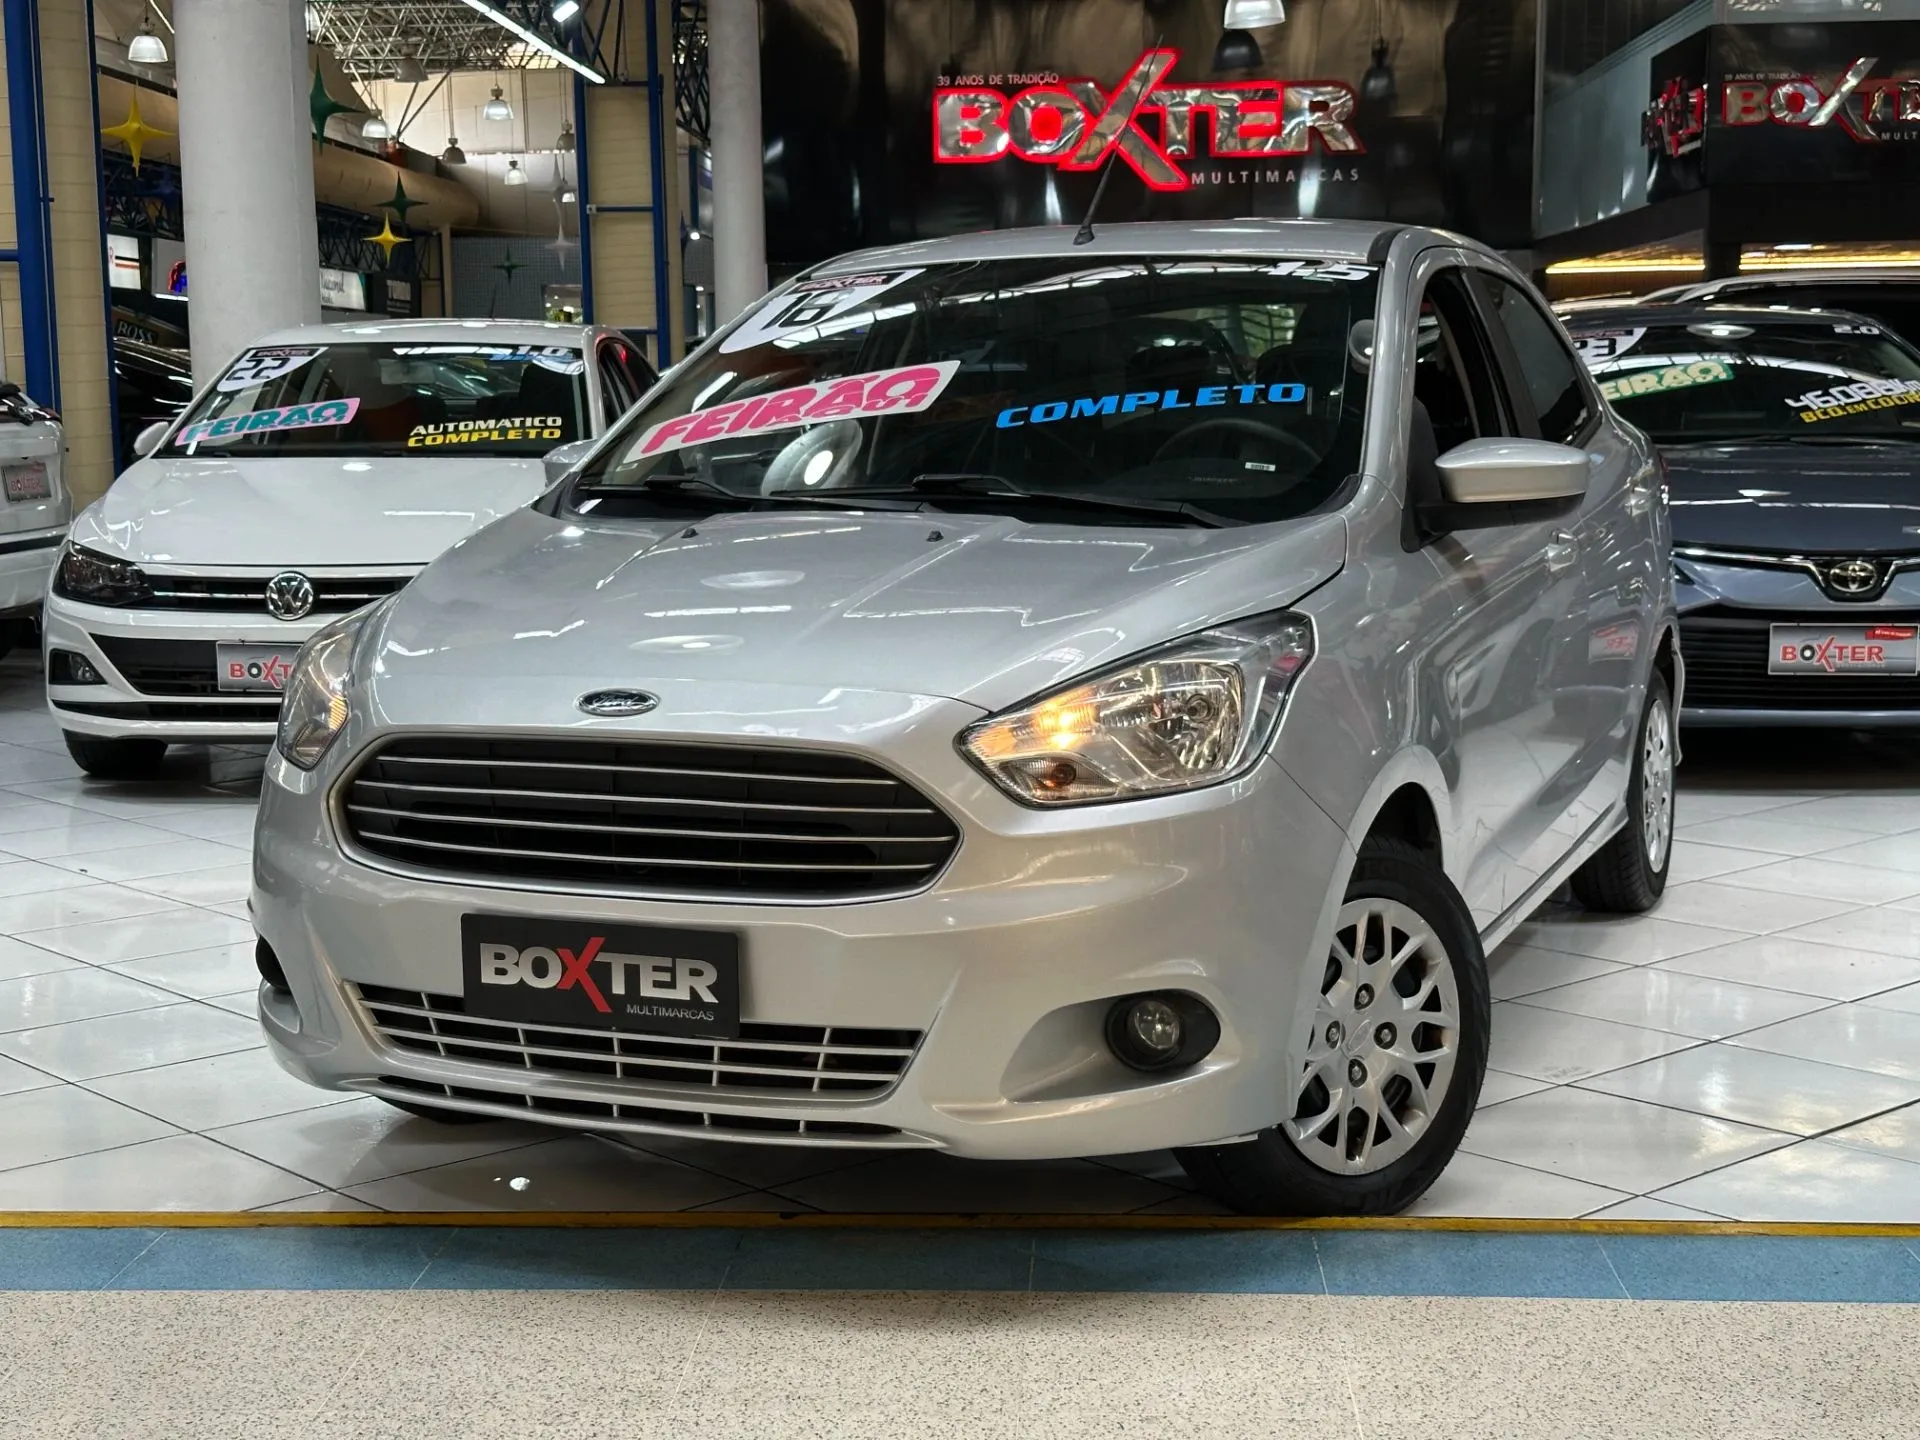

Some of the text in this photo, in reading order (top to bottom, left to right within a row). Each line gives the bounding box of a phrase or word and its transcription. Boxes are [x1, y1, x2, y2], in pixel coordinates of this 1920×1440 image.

[937, 71, 1059, 86] 39 ANOS DE TRADIÇÃO
[1722, 57, 1920, 142] BOXTE
[933, 48, 1367, 191] BOXTER
[1191, 168, 1361, 186] MULTIMARCAS
[1832, 324, 1880, 334] 2.0
[225, 357, 292, 381] 22
[1599, 361, 1726, 400] EIRÃO
[640, 367, 942, 455] FEIRÃO
[996, 383, 1306, 428] COMPLETO
[1866, 389, 1920, 409] COUR
[184, 401, 350, 443] FEIRÃO
[407, 428, 561, 447] COMPLETO
[409, 416, 562, 436] AUTOMATICO
[1780, 635, 1884, 672] BOXTER
[229, 655, 293, 689] BOXT
[480, 937, 719, 1012] BOXTER
[626, 1004, 714, 1021] MULTIMARCAS
